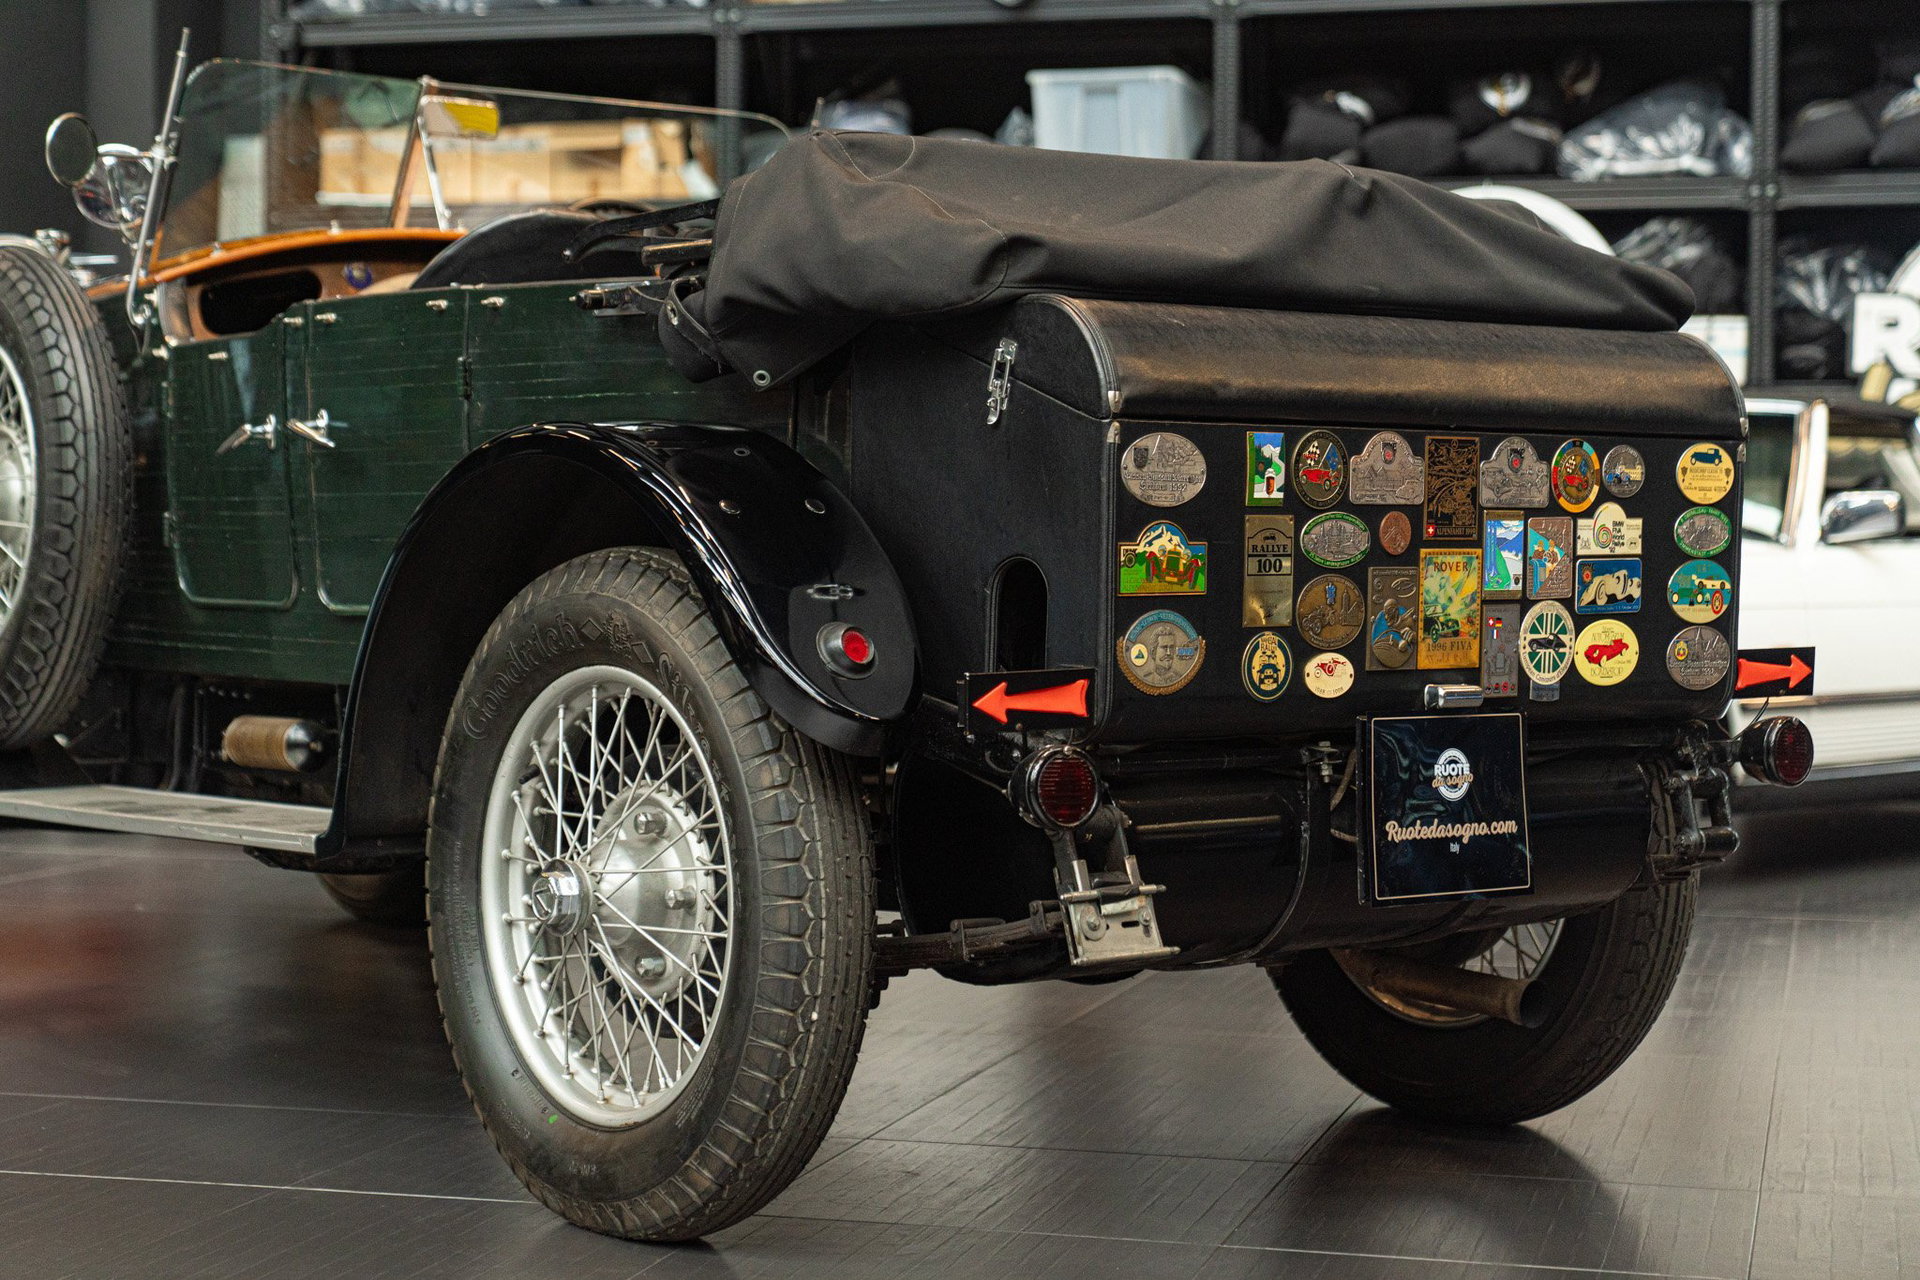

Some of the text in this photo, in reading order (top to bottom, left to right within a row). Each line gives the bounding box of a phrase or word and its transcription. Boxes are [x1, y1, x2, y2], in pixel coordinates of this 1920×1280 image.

[1250, 544, 1288, 553] RALLYE
[1256, 558, 1283, 574] 100
[1433, 561, 1468, 572] ROVER
[1427, 641, 1472, 652] 1996 FIVA
[1433, 763, 1471, 776] RUOTE
[1432, 773, 1474, 789] da sogno
[1385, 818, 1518, 845] Ruotedasogno.com
